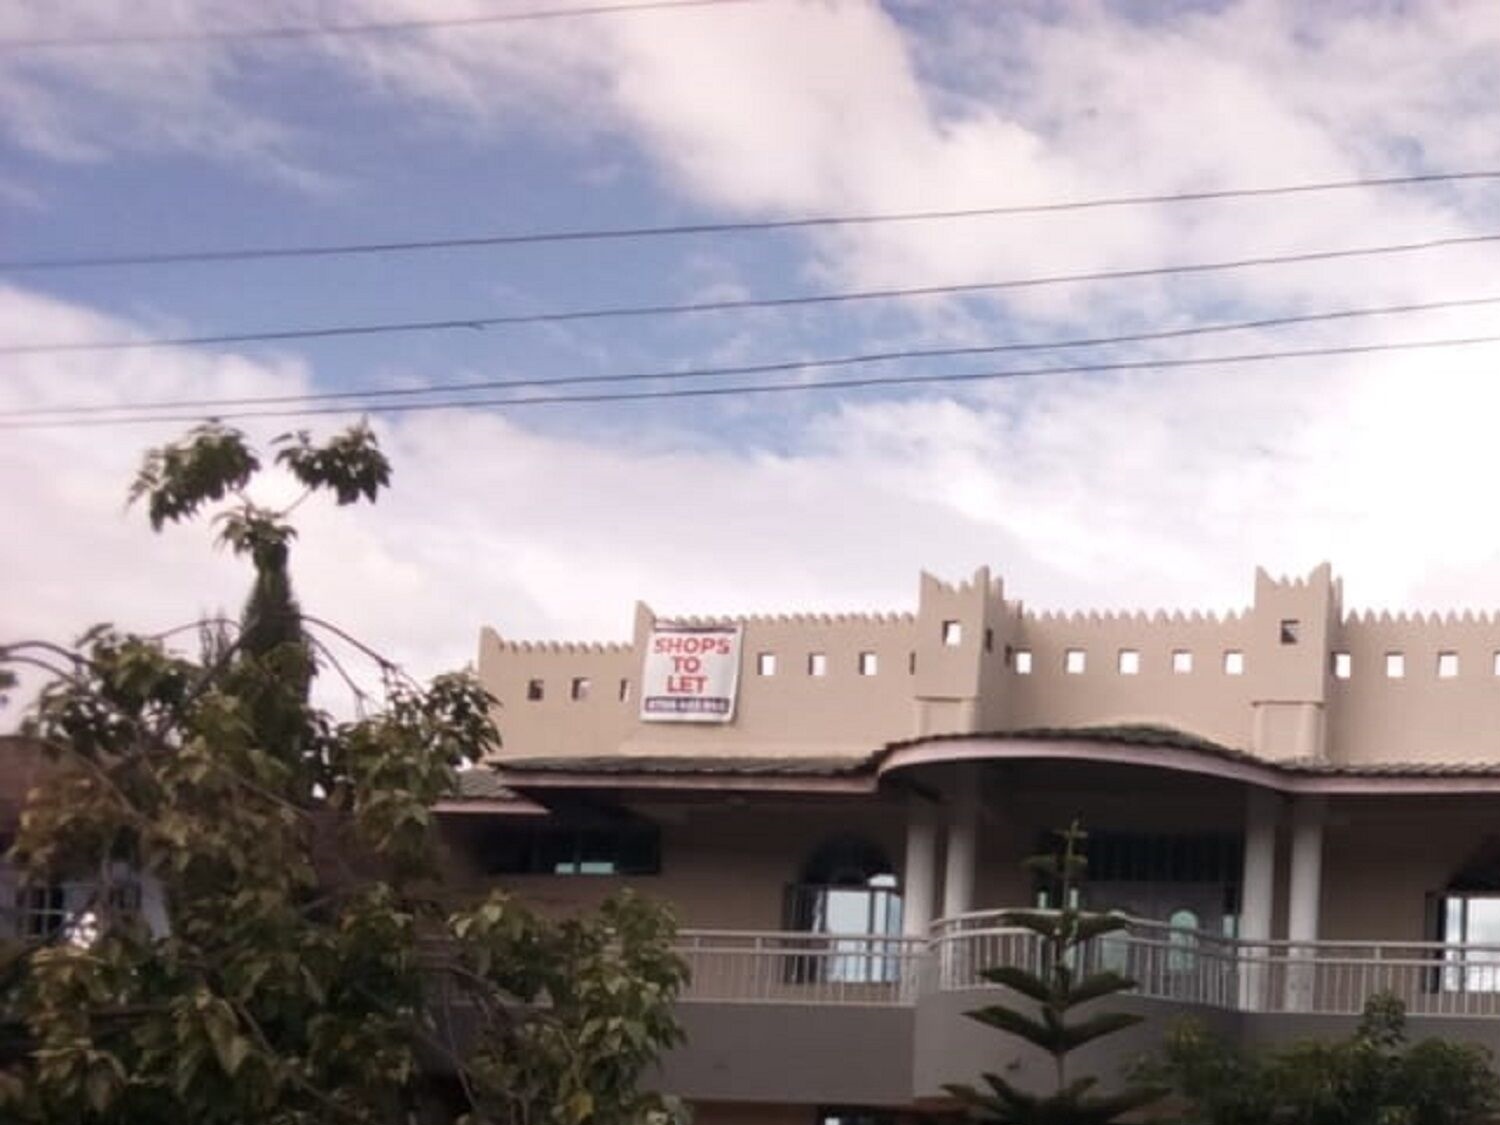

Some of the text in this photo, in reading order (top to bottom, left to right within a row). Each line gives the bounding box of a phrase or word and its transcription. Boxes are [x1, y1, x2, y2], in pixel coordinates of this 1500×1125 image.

[655, 637, 731, 654] SHOPS
[672, 655, 701, 673] TO
[667, 675, 707, 694] LET
